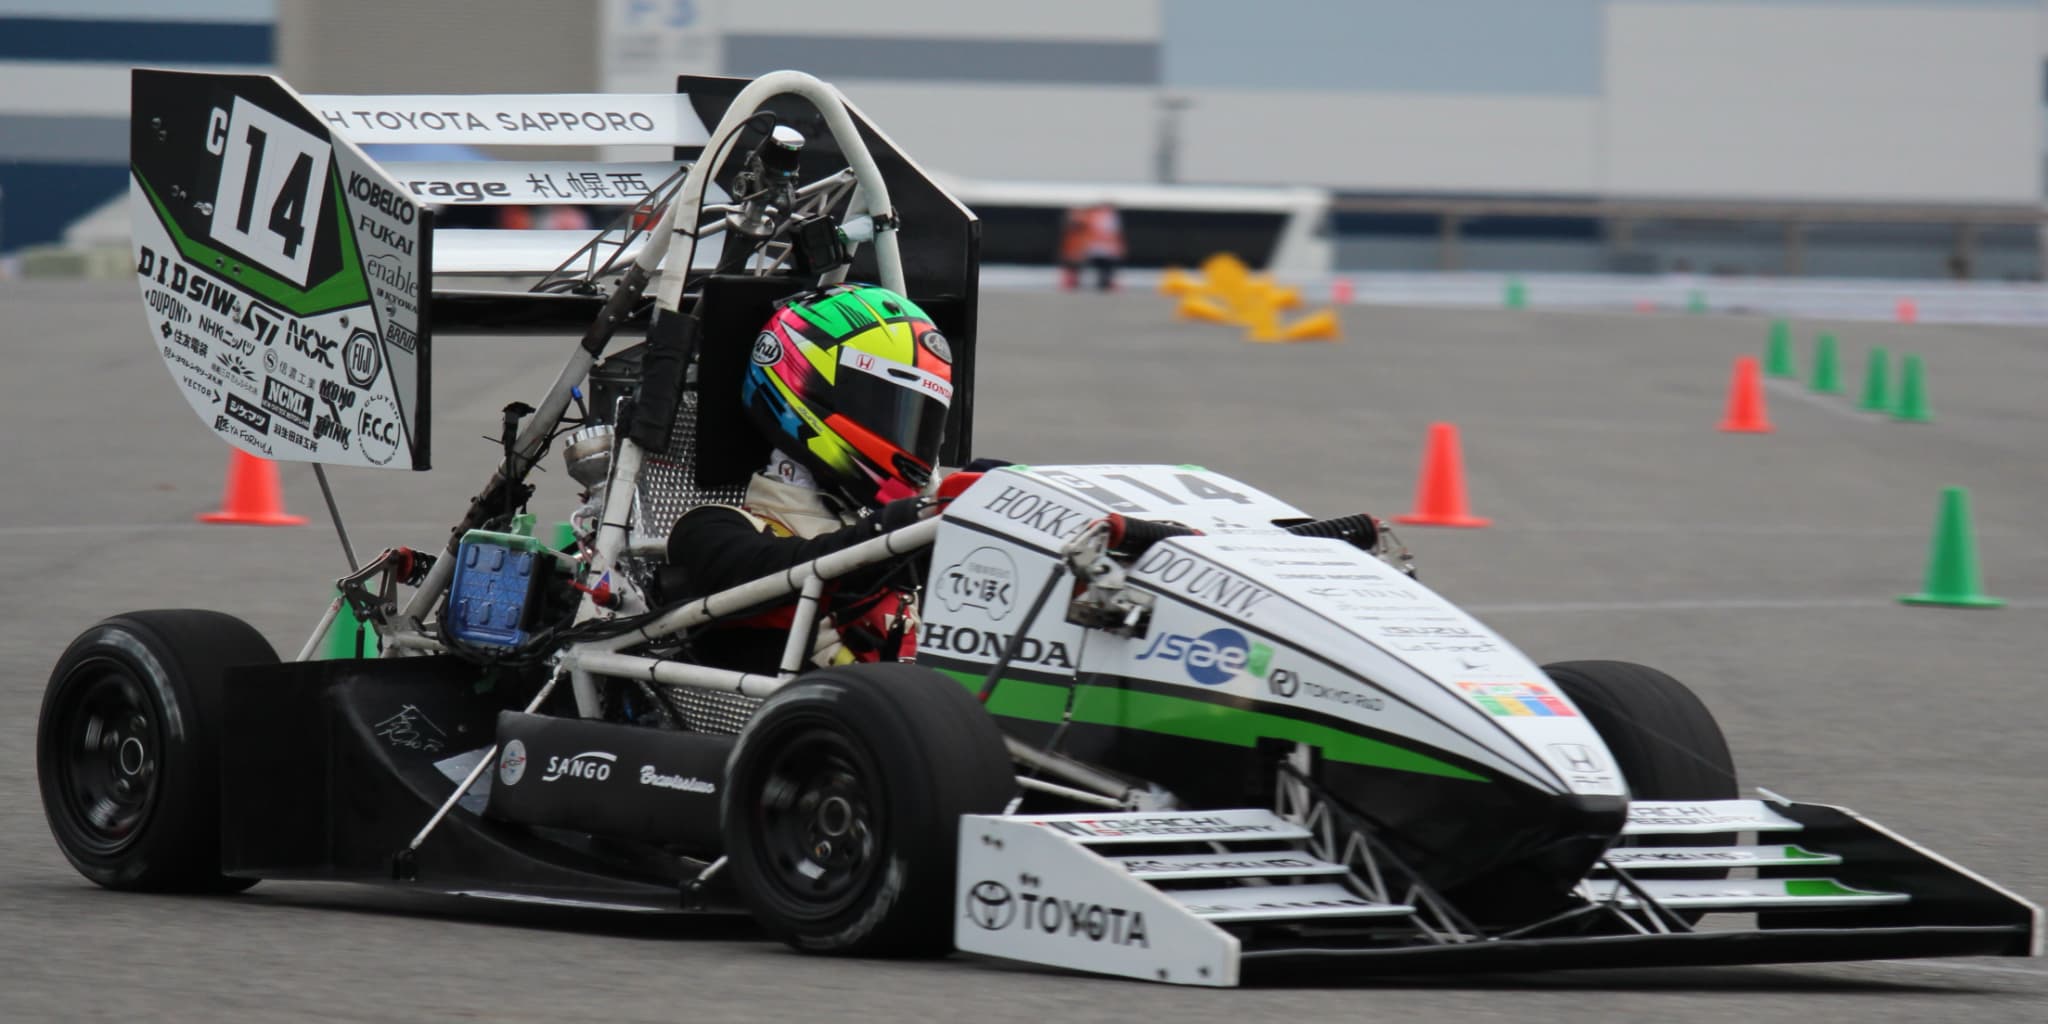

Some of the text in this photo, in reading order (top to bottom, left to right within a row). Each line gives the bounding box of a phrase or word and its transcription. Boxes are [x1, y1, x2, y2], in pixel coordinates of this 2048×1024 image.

[352, 111, 491, 132] TOYOTA
[497, 111, 655, 132] SAPPORO
[206, 106, 314, 260] C 14
[348, 171, 415, 225] KOBELCO
[400, 171, 651, 202] rage 札幌西
[359, 214, 414, 256] FUKAI
[367, 256, 418, 298] enable
[149, 289, 188, 325] DUPONT
[285, 319, 338, 369] NOK
[352, 343, 372, 375] FUJI
[183, 375, 212, 397] VECTOR
[268, 380, 308, 418] NCML
[362, 412, 396, 447] F.C.C.
[1104, 474, 1255, 506] 14
[949, 572, 1011, 606] ていほく
[1188, 558, 1274, 619] UNIV.
[920, 622, 1074, 669] HONDA
[547, 755, 612, 782] SANGO
[1019, 893, 1151, 949] TOYOTA
